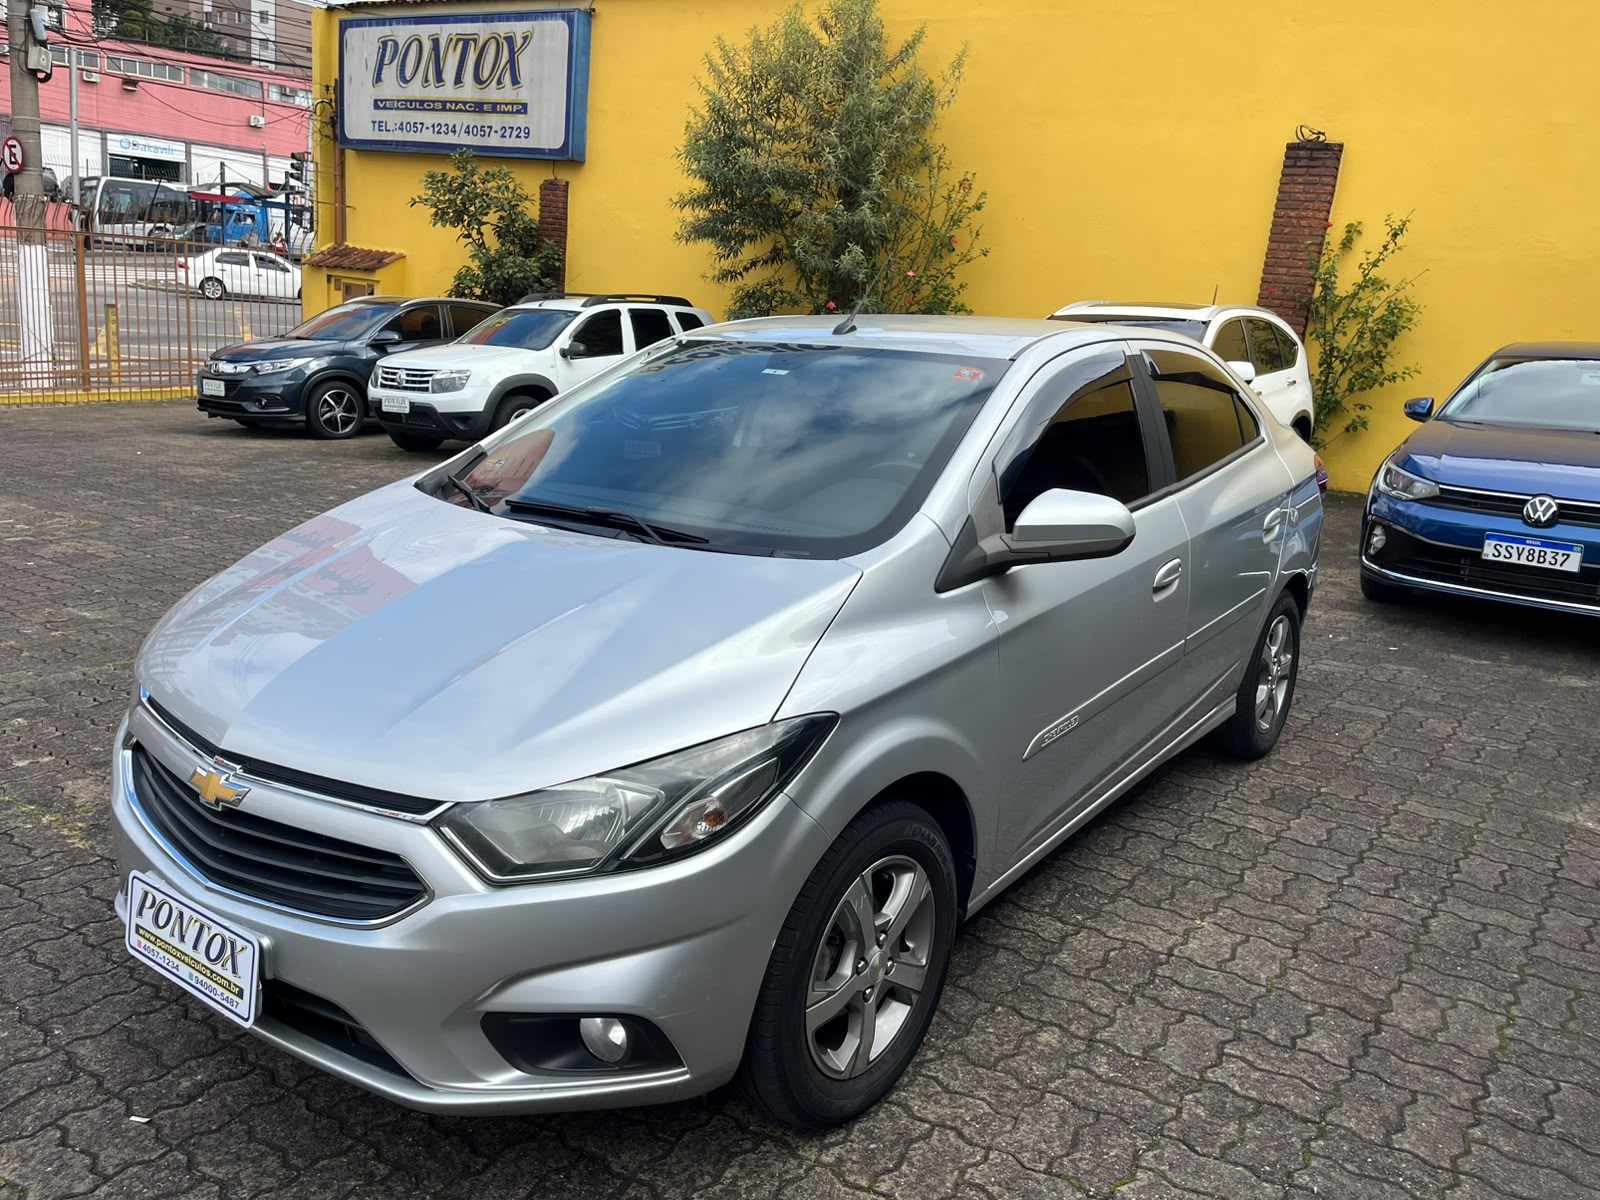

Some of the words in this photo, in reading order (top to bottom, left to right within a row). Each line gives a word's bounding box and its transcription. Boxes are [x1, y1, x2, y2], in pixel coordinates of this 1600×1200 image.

[372, 30, 534, 90] PONTOX
[446, 102, 479, 111] NAC.
[483, 104, 493, 112] E
[497, 104, 525, 112] IMP.
[1492, 543, 1571, 567] SSY8B37
[136, 888, 247, 979] PONTOX
[139, 928, 240, 995] www.pontoxveiculos.com.br
[143, 943, 179, 972] 4057-1234
[194, 975, 239, 1009] 94000-5487
